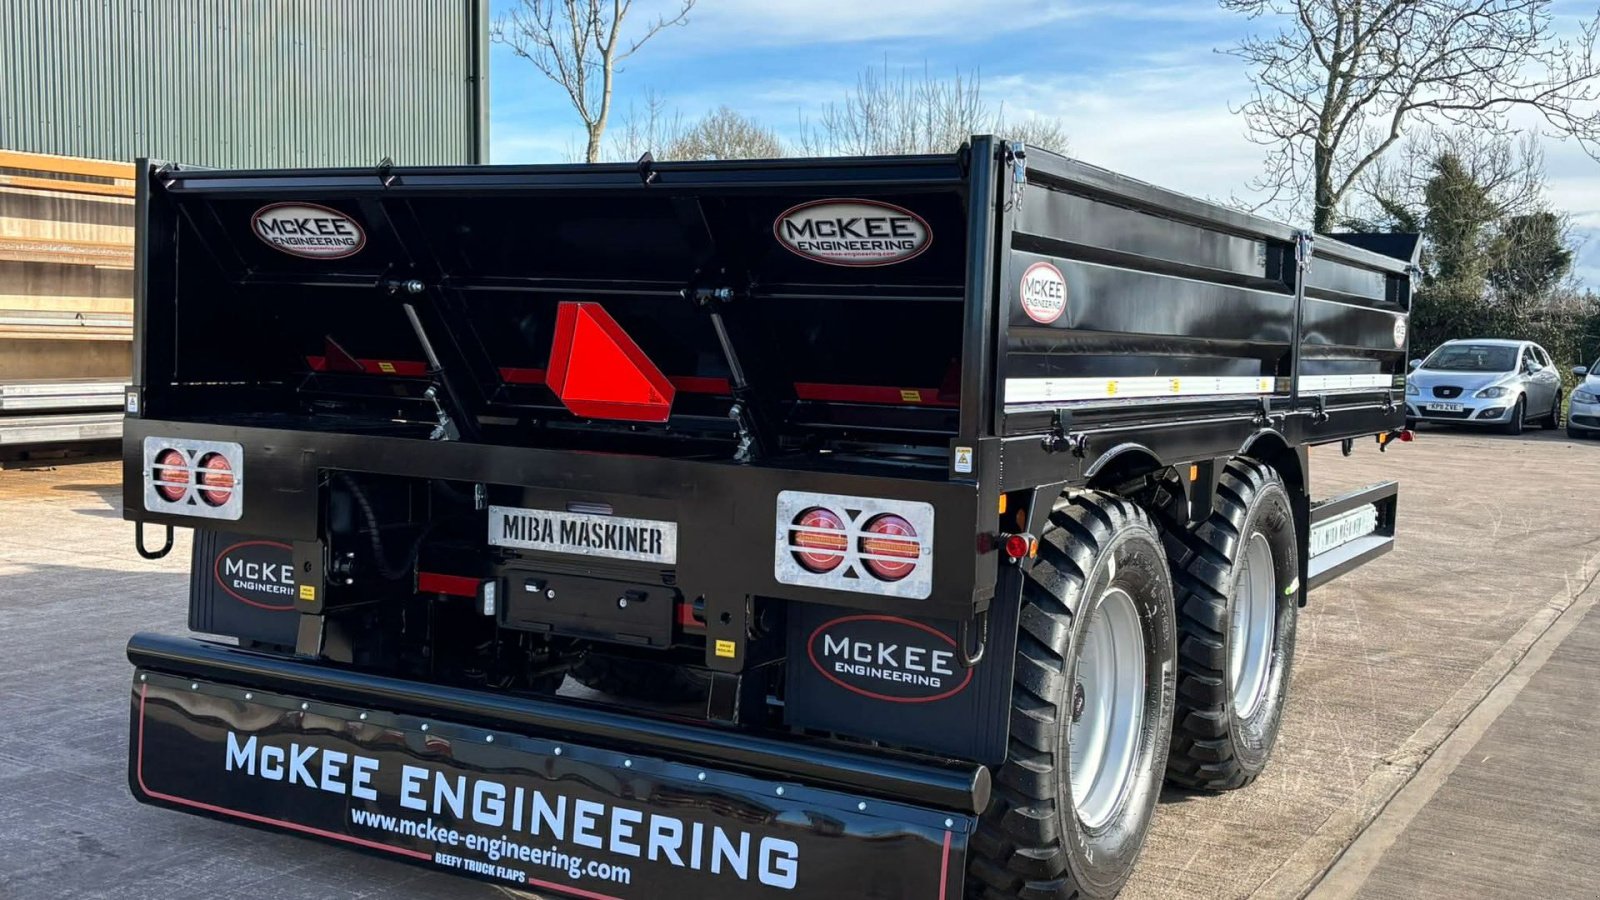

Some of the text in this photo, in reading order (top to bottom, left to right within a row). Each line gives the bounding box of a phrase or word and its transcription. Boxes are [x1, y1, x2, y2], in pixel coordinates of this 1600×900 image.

[272, 237, 355, 246] ENGINEERING
[797, 240, 914, 251] ENGINEERING
[503, 514, 662, 555] MIBA MASKINER
[225, 556, 295, 585] McKE
[233, 579, 295, 596] ENGINEERI
[835, 661, 941, 688] ENGINEERING
[400, 764, 798, 890] ENGINEERING
[351, 808, 631, 884] www.mckee-engineering.com
[435, 852, 526, 883] BEEFY TRUCK FLAPS
